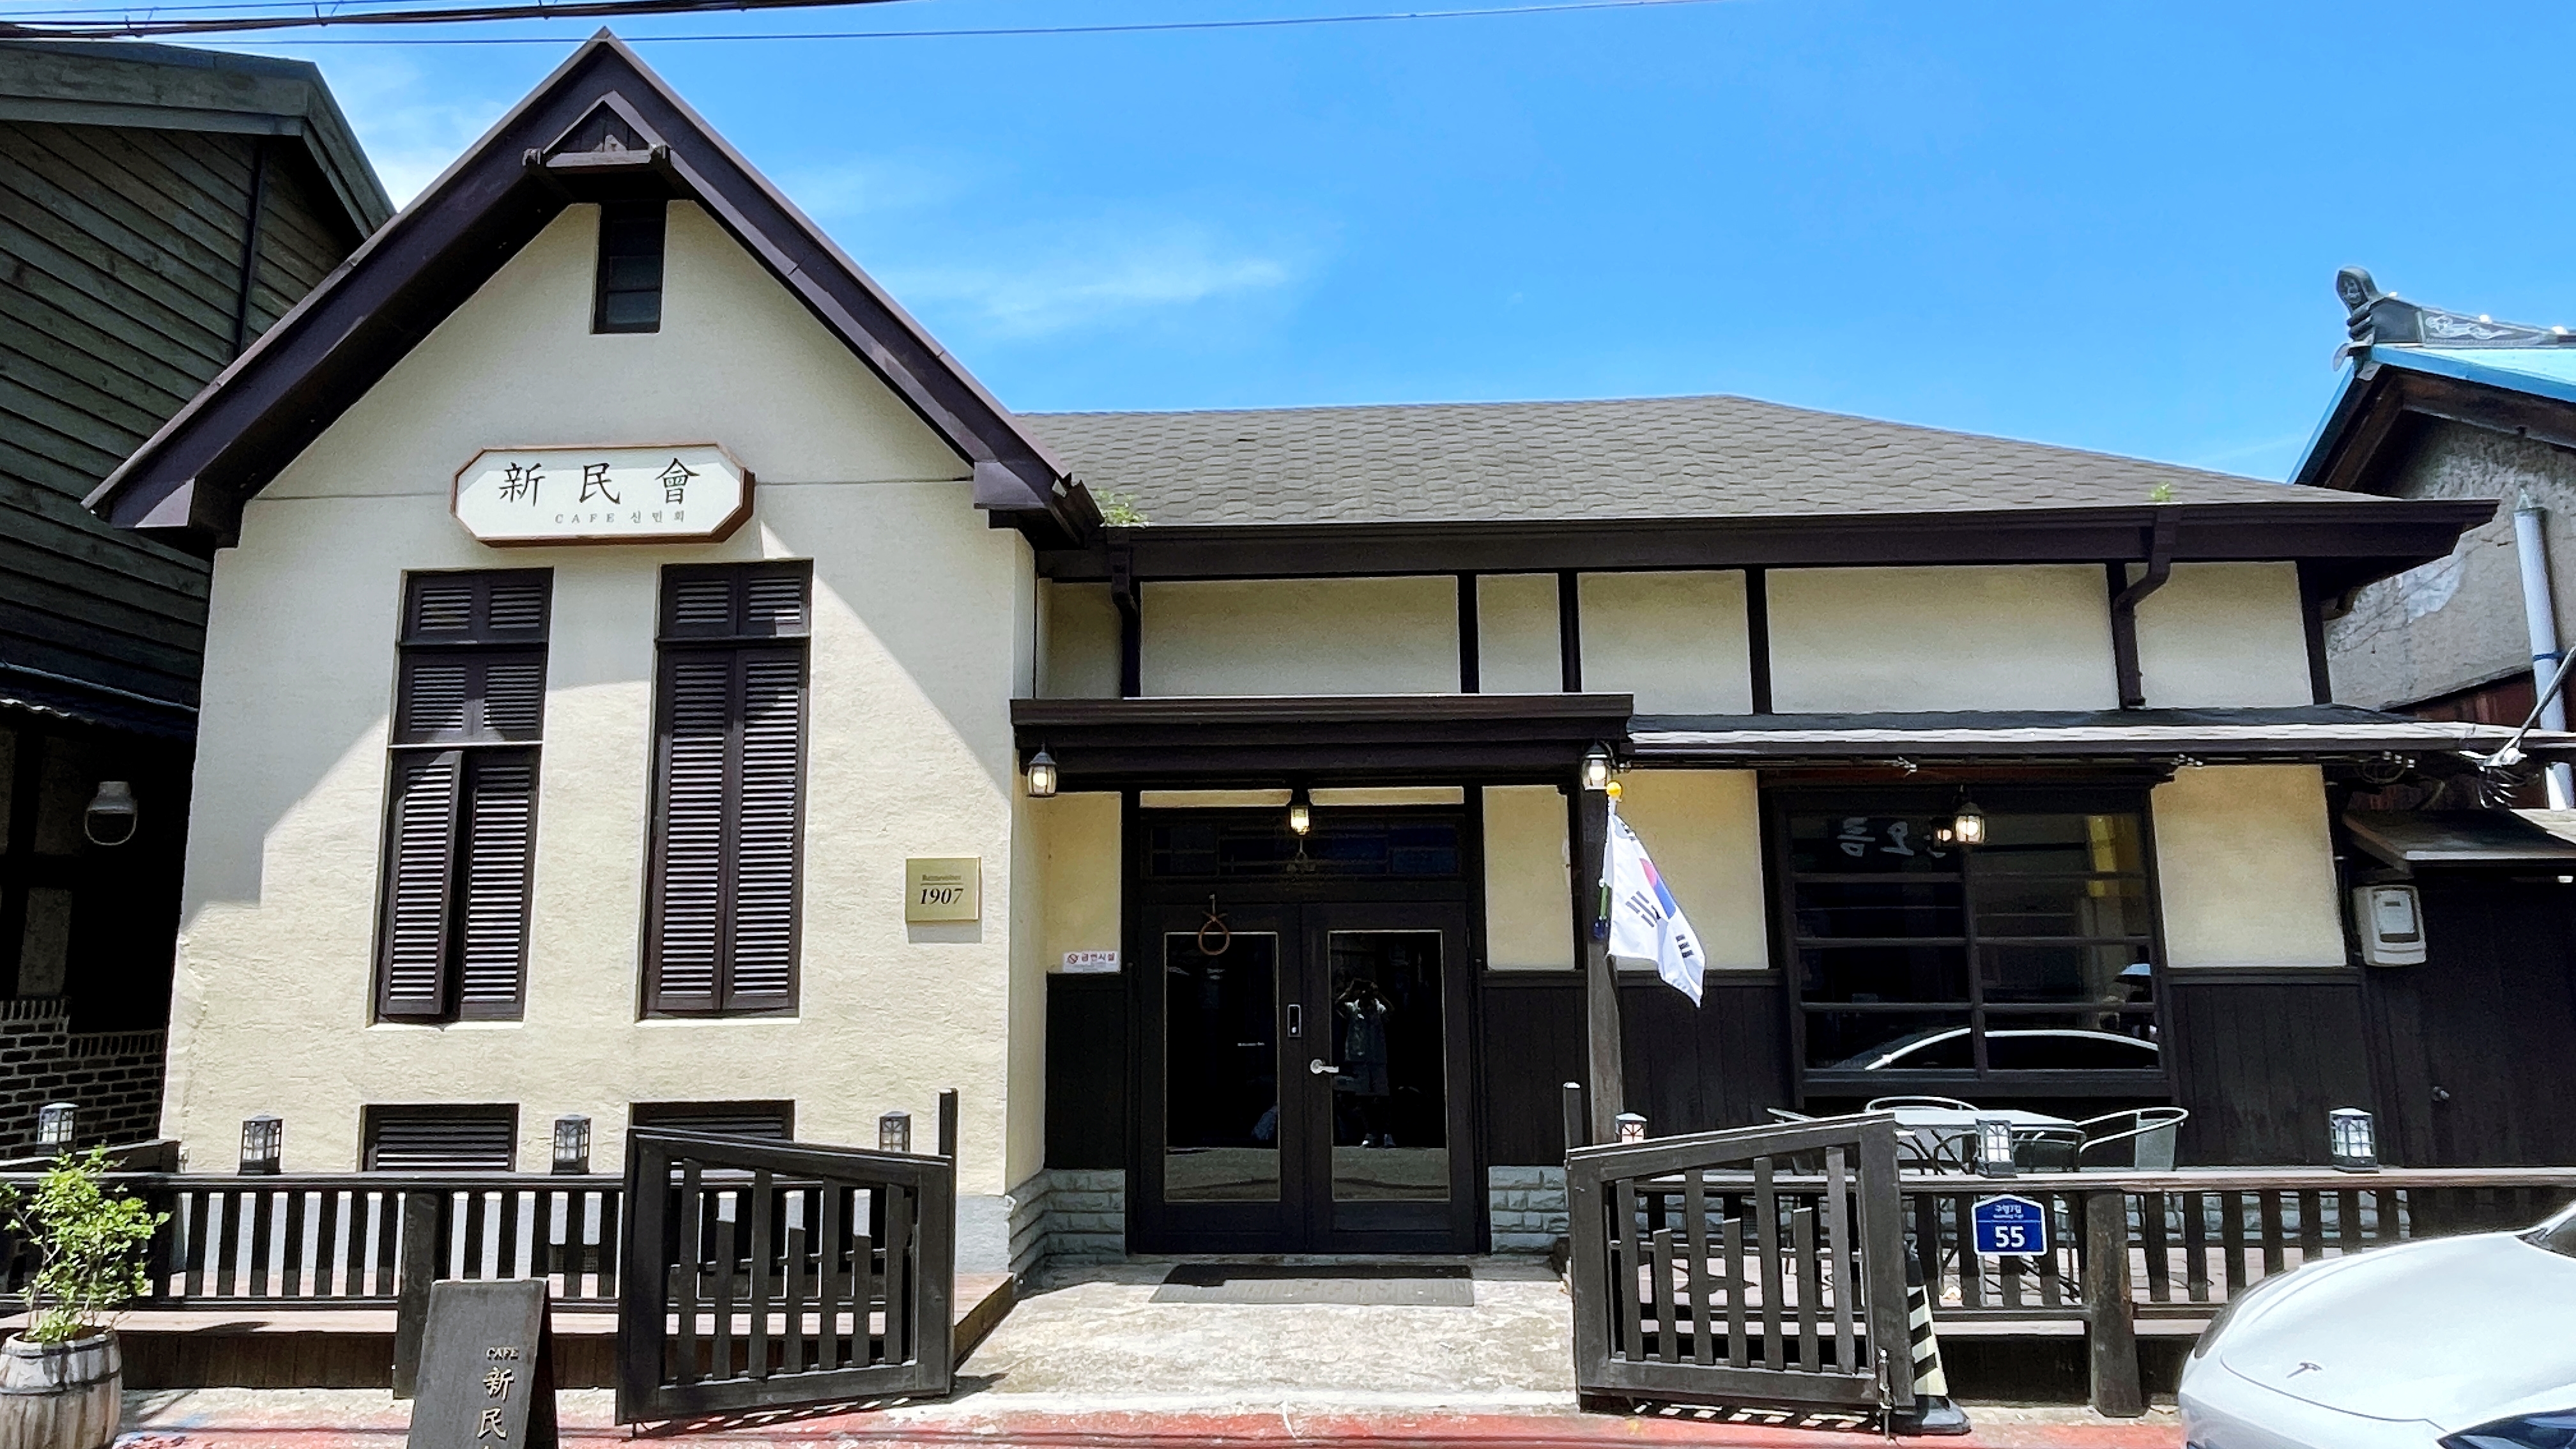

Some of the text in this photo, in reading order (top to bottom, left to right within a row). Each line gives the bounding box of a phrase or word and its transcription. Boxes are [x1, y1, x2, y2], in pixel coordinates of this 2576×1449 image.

[498, 457, 700, 507] 新民會
[555, 510, 685, 524] CAFE 신민회
[921, 887, 964, 905] 1907
[1995, 1225, 2025, 1248] 55
[486, 1346, 519, 1361] CAFE
[477, 1366, 515, 1449] 新民
